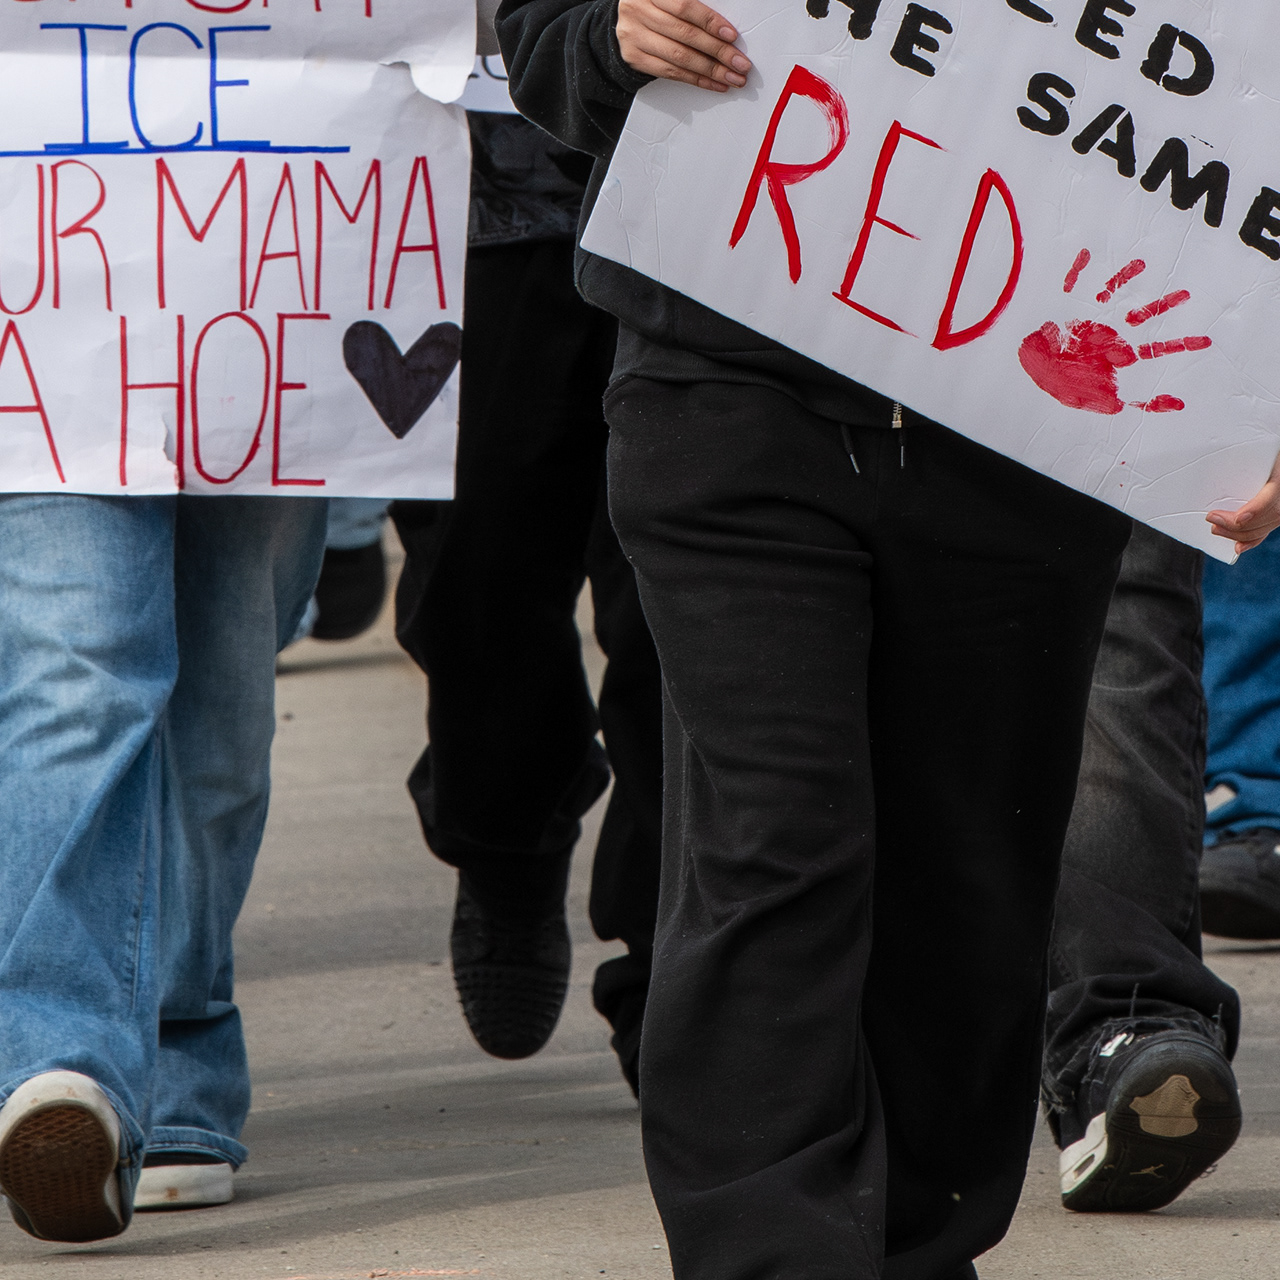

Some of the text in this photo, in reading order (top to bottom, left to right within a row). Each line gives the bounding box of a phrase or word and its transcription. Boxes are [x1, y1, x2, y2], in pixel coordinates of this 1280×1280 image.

[39, 21, 273, 152] ICE
[156, 156, 447, 312] MAMA
[728, 64, 1025, 353] RED
[120, 310, 332, 490] HOE
